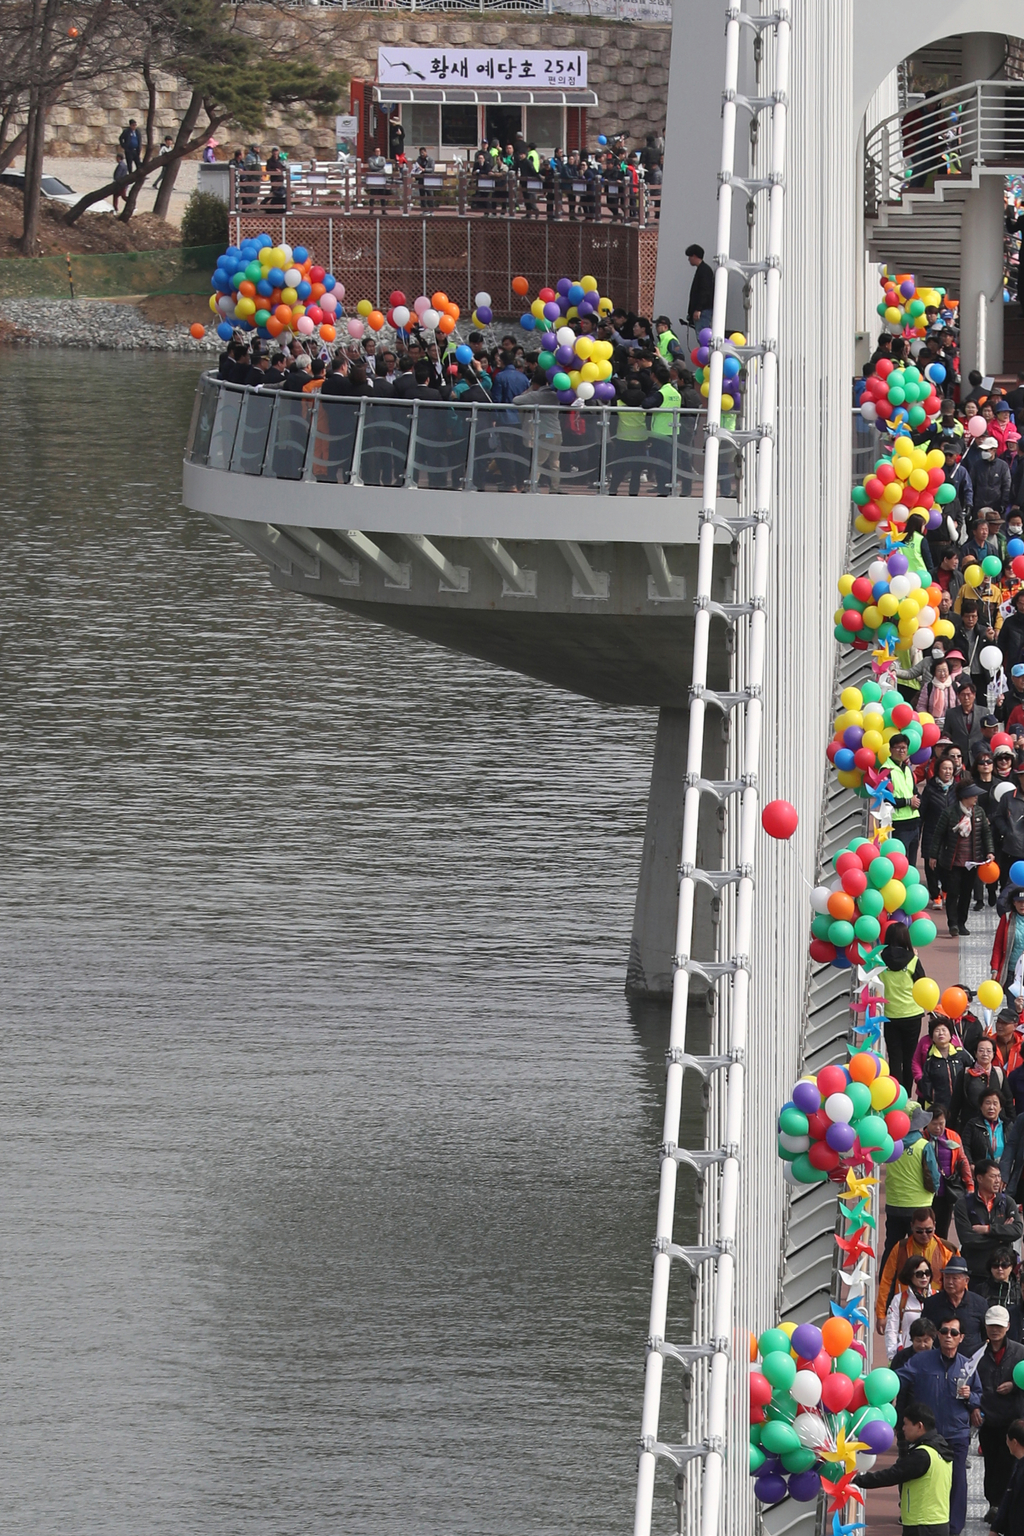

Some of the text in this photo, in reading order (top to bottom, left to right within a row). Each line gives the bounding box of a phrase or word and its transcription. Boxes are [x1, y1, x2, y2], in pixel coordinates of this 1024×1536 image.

[430, 55, 581, 80] 황새 예당호 25시
[548, 76, 575, 86] 편의점
